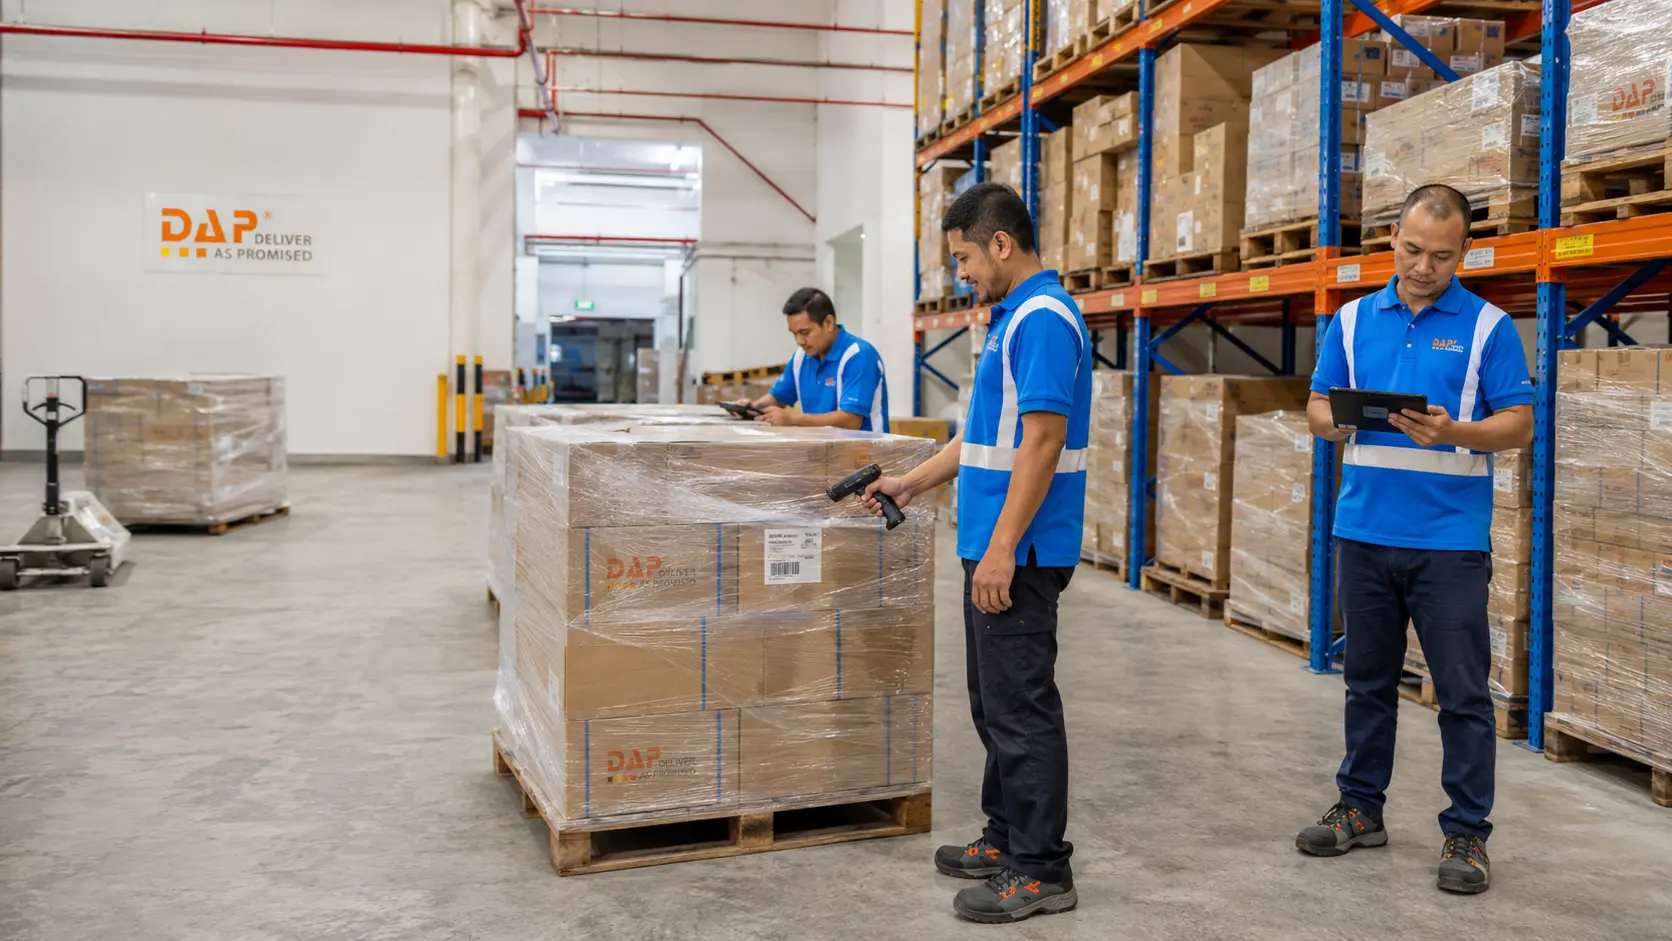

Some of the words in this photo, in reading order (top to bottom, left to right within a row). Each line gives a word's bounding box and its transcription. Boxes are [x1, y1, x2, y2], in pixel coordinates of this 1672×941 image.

[1612, 79, 1656, 112] DAP
[161, 208, 258, 244] DAP
[254, 233, 312, 246] DELIVER
[213, 248, 232, 259] AS
[237, 248, 312, 261] PROMISED
[607, 556, 662, 579] DAP
[607, 747, 662, 772] DAP
